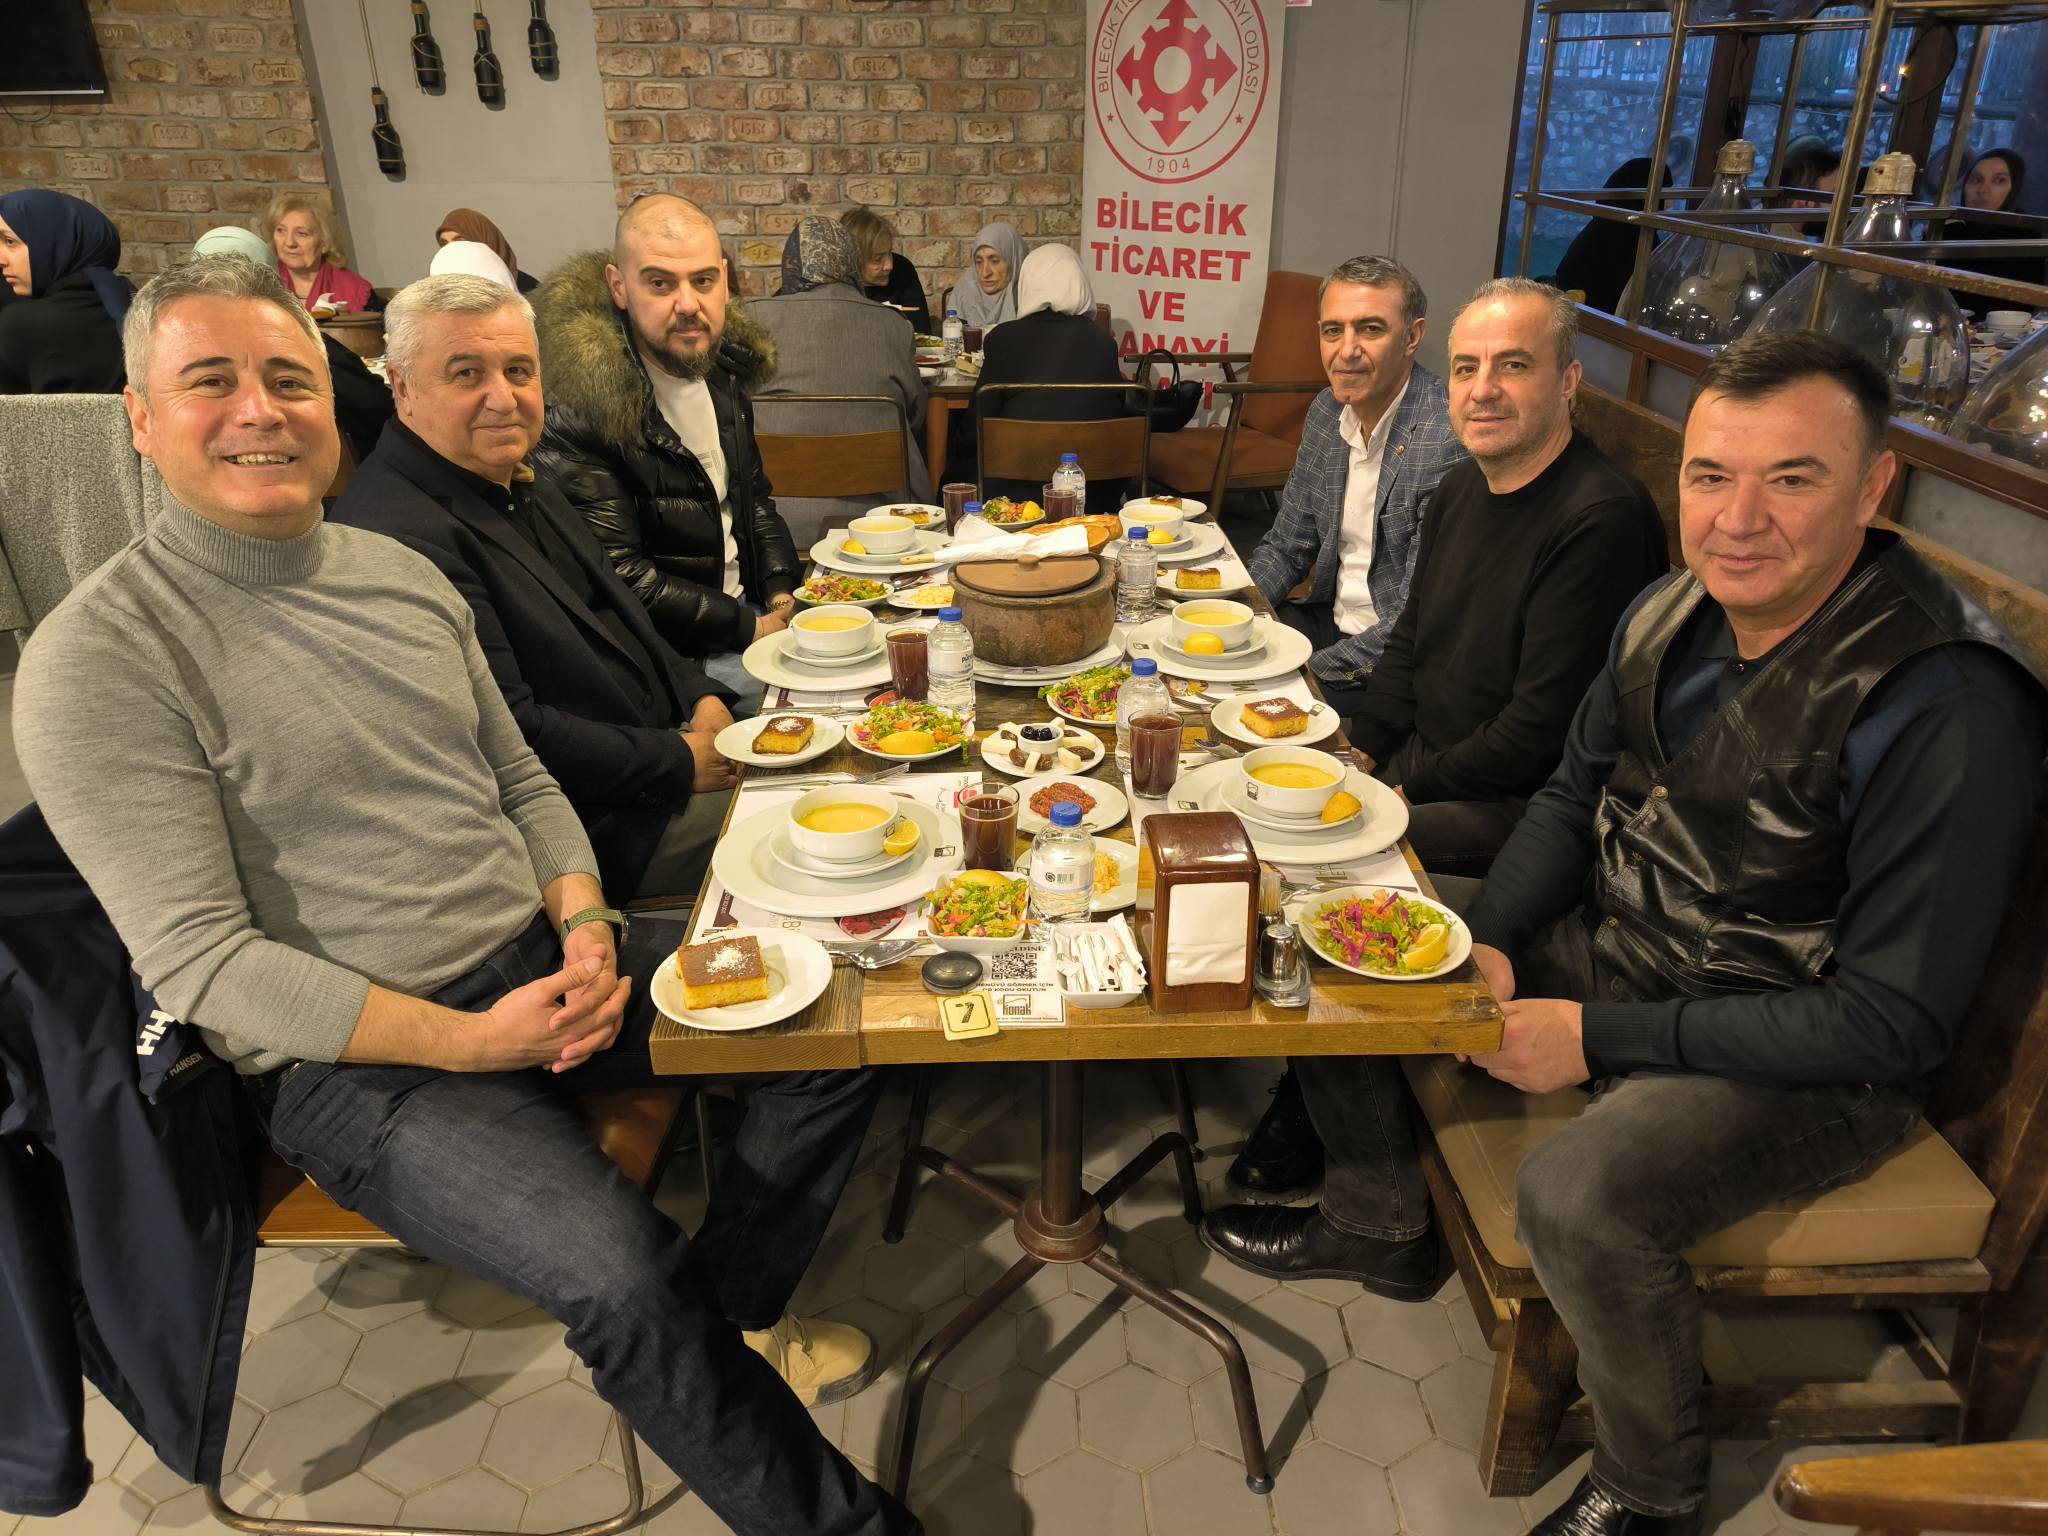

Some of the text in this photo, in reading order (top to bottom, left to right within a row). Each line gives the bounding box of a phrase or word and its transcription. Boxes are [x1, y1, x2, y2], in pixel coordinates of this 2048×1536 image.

[1243, 29, 1260, 94] ODASI
[1146, 156, 1191, 174] 1904
[1096, 191, 1249, 236] BİLECİK
[1090, 235, 1251, 283] TİCARET
[1137, 288, 1186, 323] VE
[1119, 330, 1230, 369] ANAYİ
[955, 1001, 975, 1024] 7
